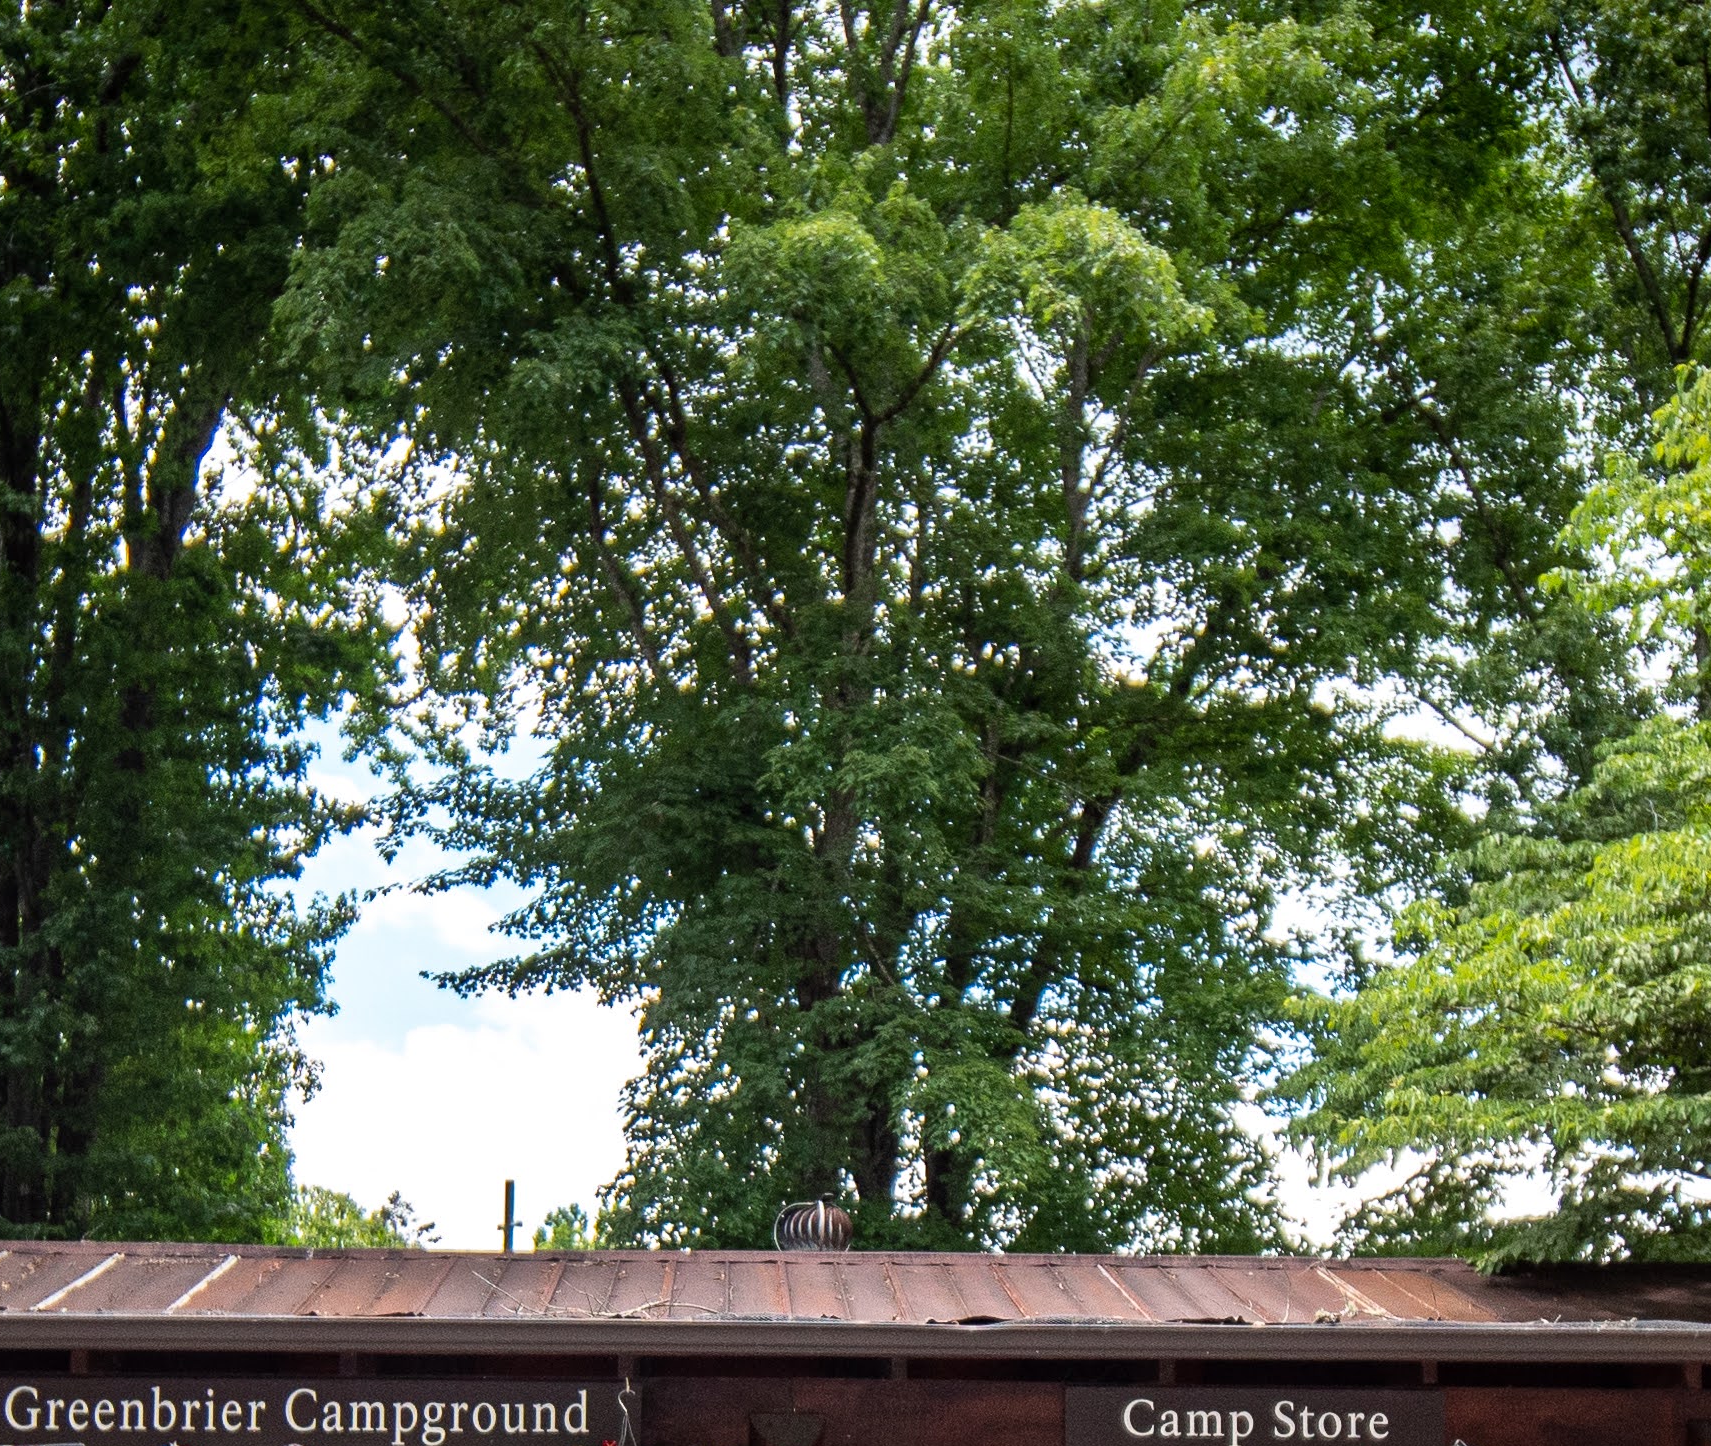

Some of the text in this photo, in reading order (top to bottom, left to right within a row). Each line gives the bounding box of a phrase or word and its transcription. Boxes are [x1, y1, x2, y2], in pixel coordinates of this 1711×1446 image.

[4, 1386, 589, 1446] Greenbrier Campground
[1273, 1400, 1390, 1439] Store
